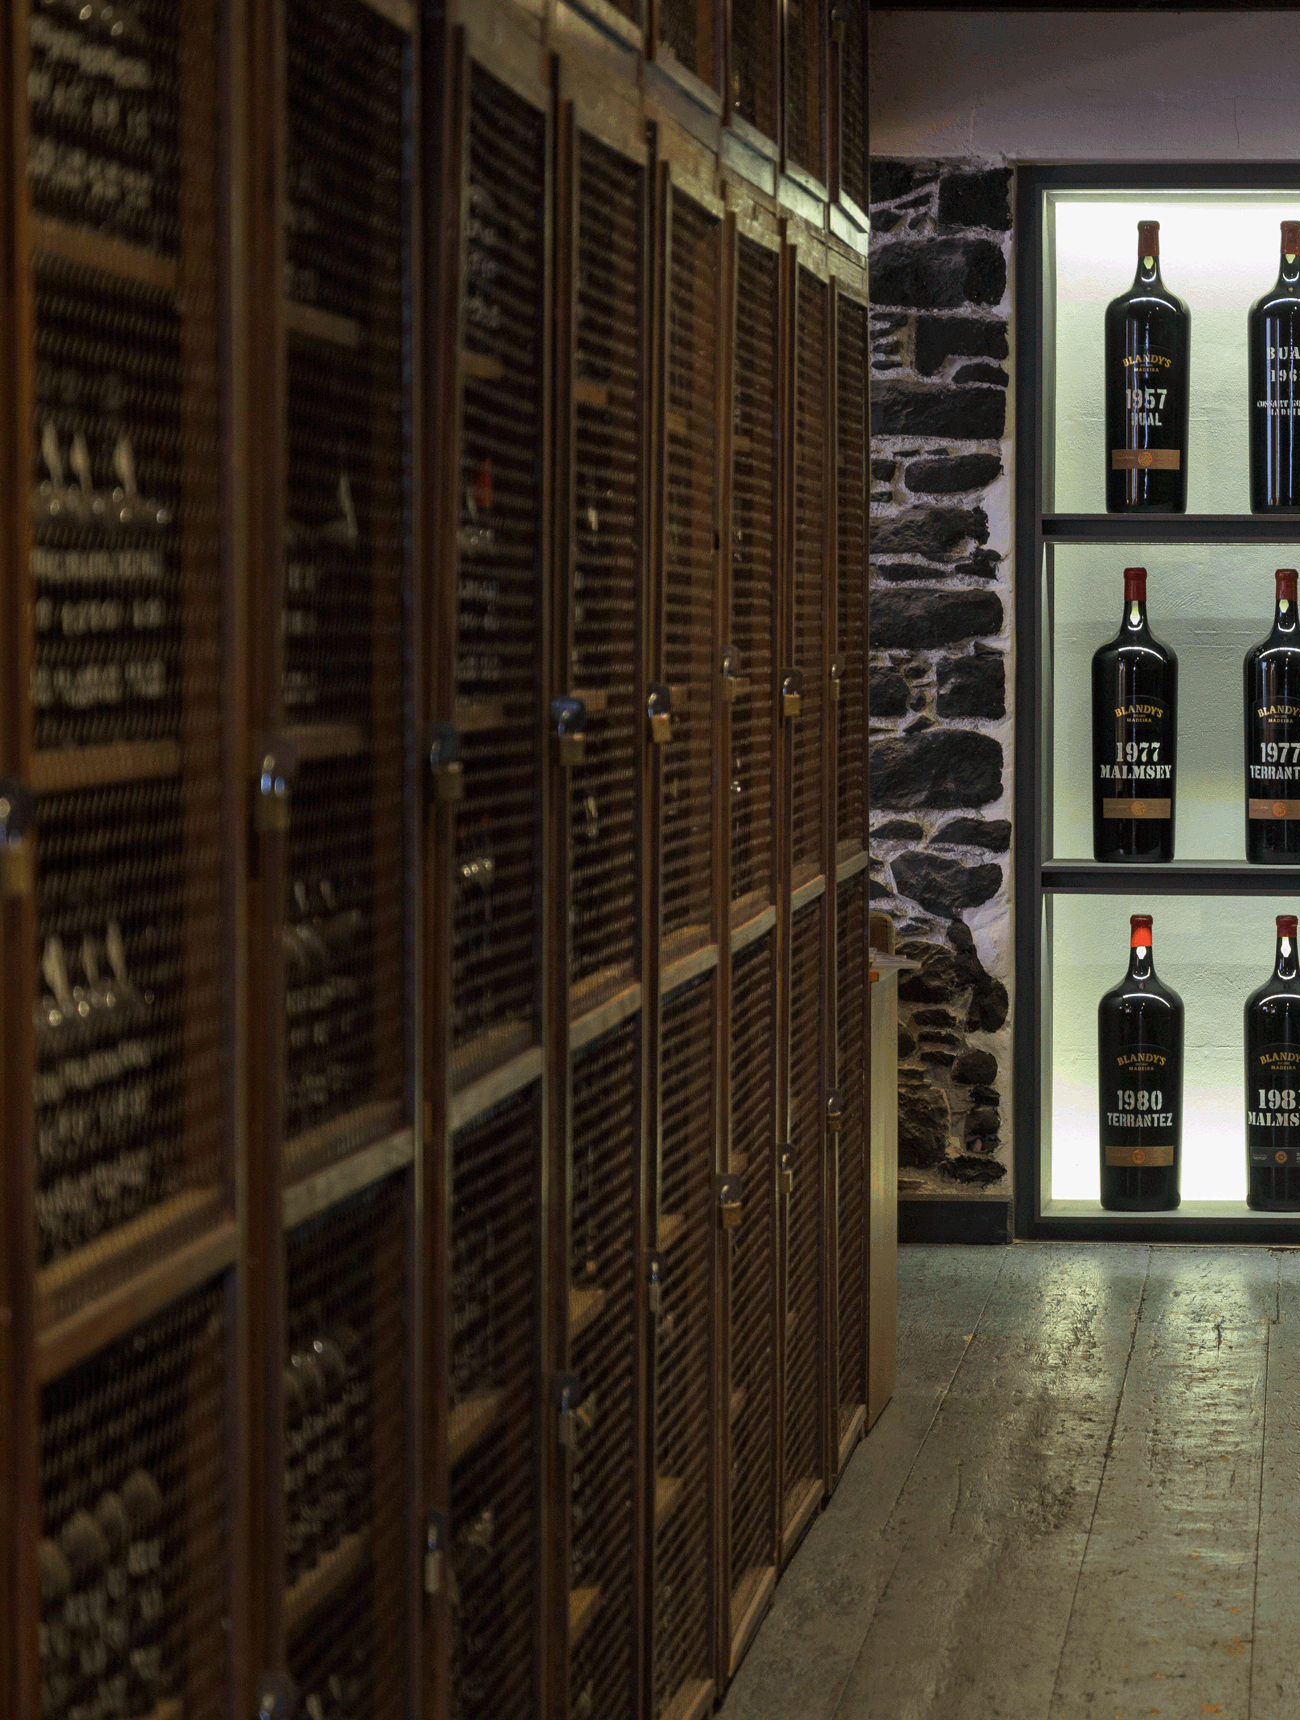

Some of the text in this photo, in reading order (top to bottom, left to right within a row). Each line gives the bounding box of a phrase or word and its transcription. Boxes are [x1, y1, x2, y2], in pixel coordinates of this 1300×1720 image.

[1122, 354, 1171, 368] BLANDY'S
[1126, 388, 1167, 409] 1957
[1131, 412, 1162, 426] BUAL
[1114, 704, 1163, 718] BLANDY'S
[1116, 742, 1160, 762] 1977
[1100, 765, 1172, 779] MALMSEY
[1117, 1053, 1166, 1066] BLANDY'S
[1117, 1089, 1163, 1111] 1980
[1107, 1112, 1173, 1127] TERRANTEZ
